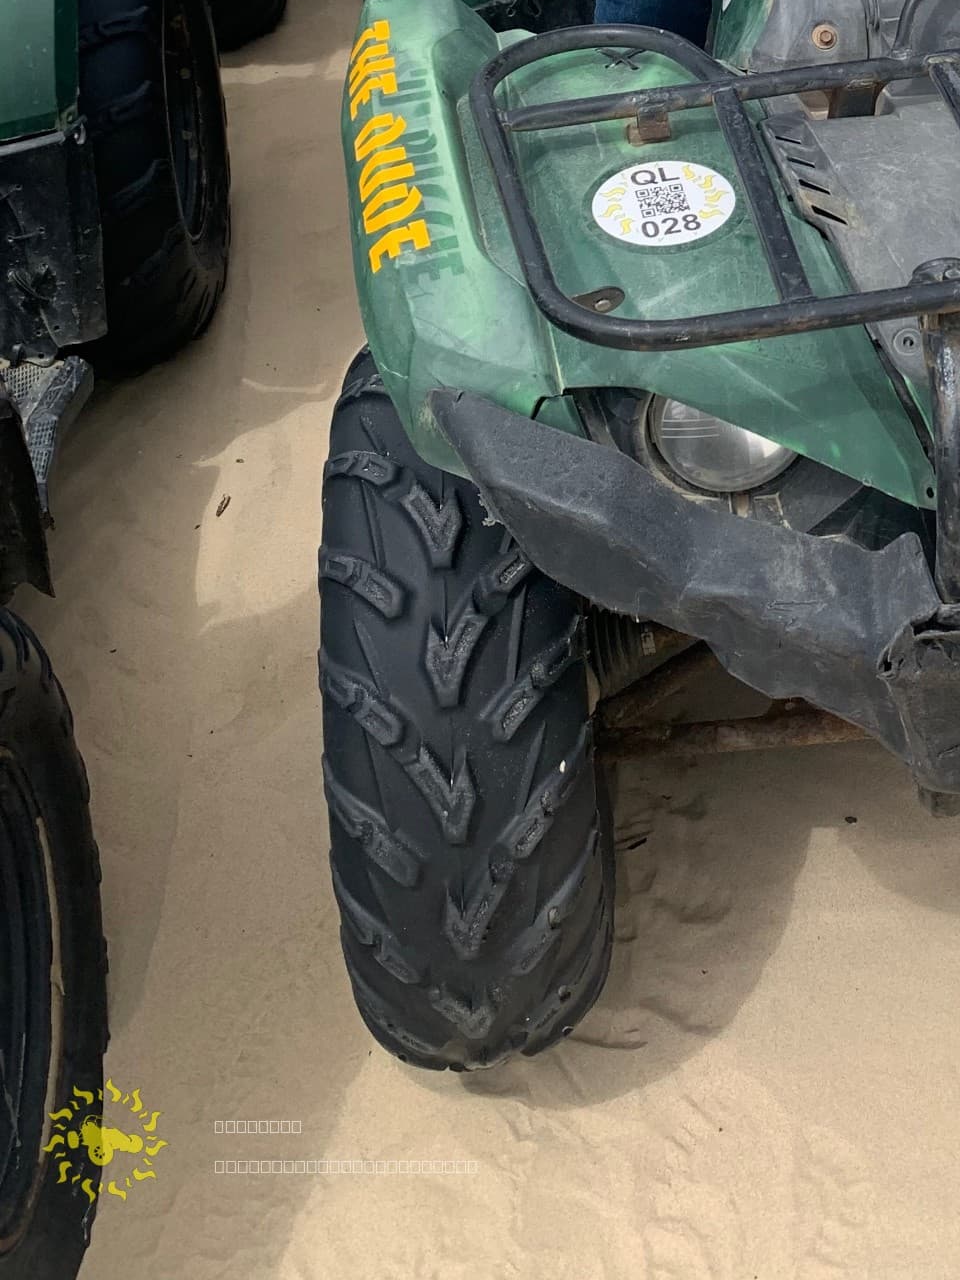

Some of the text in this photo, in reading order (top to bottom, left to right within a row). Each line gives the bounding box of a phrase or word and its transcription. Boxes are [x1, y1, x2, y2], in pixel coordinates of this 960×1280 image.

[349, 19, 398, 122] THE
[354, 113, 433, 276] DUDE
[630, 167, 680, 186] QL
[641, 213, 702, 238] 028
